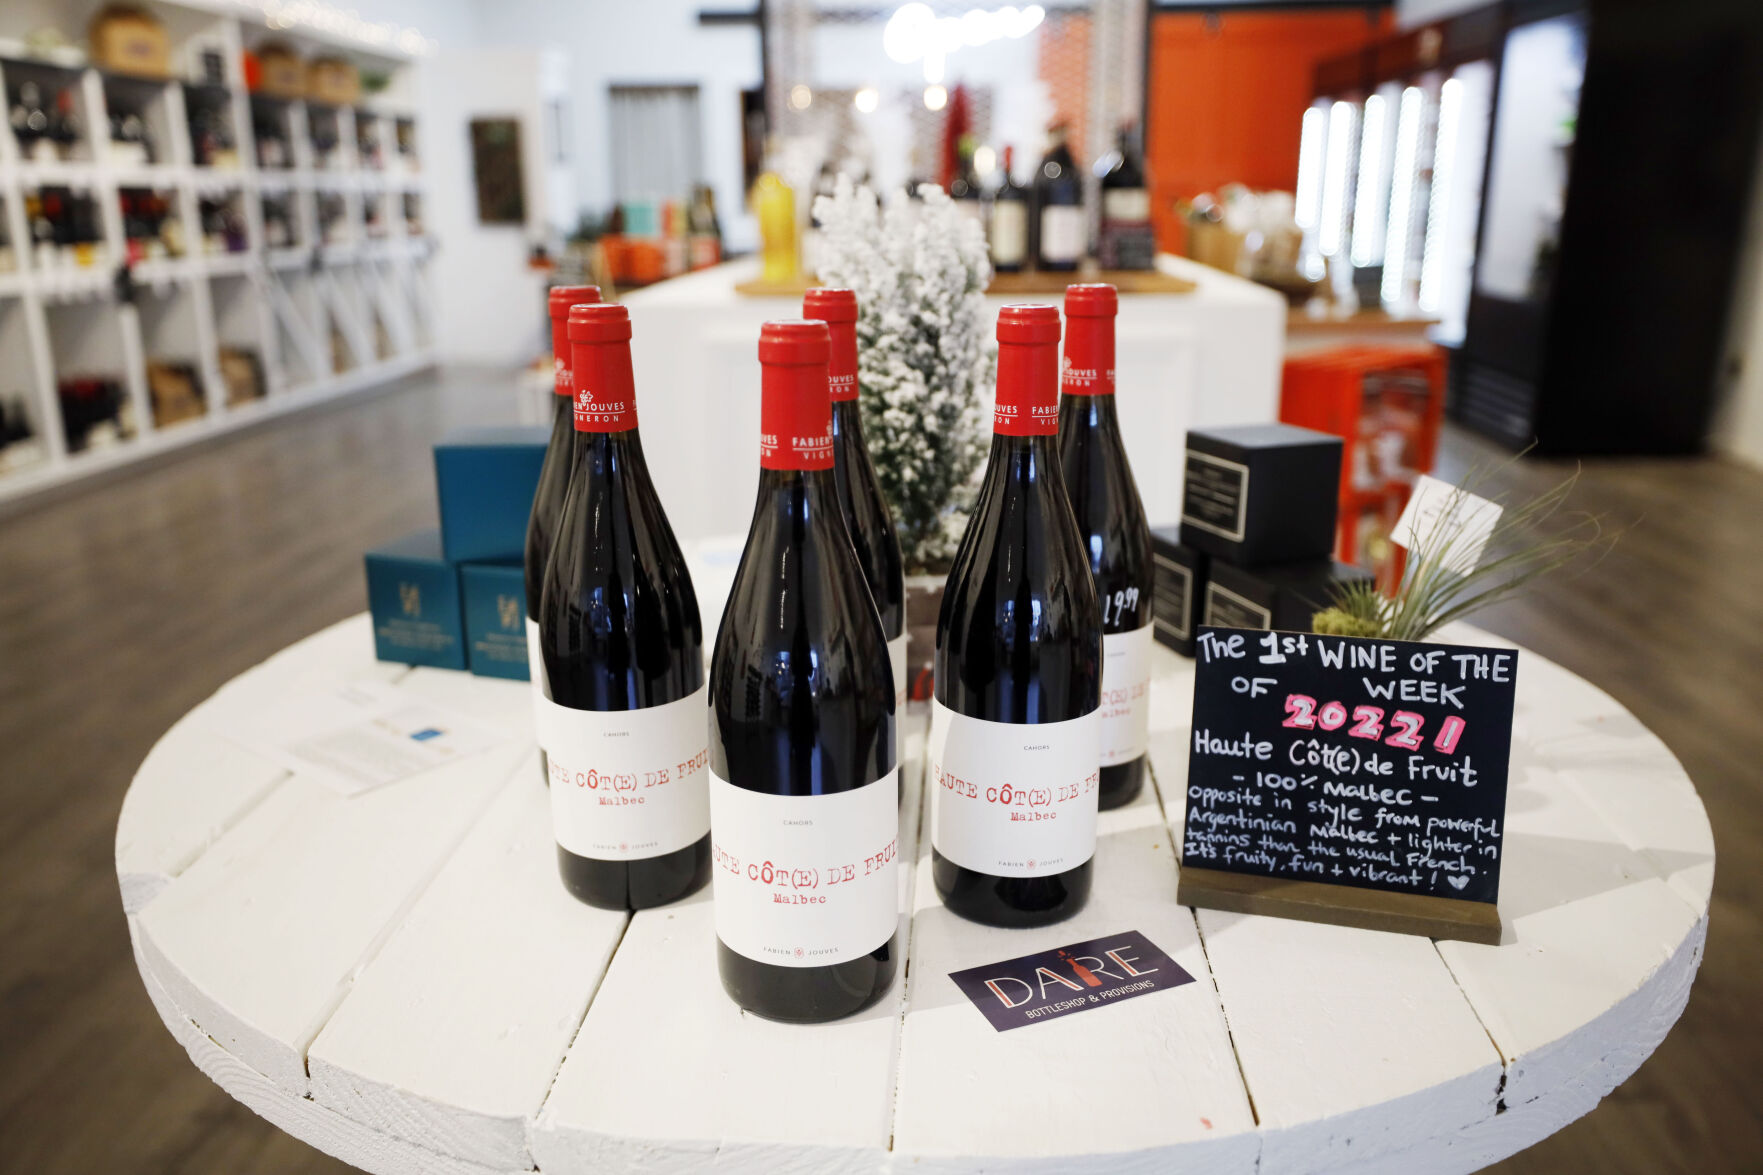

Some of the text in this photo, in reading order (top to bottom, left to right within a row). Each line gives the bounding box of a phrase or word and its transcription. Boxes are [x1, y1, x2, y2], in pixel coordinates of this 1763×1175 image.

[586, 402, 625, 411] JOUVES
[1197, 632, 1511, 682] The 1st WINE OF THE
[1231, 676, 1278, 698] OF
[1363, 677, 1466, 710] WEEK
[575, 768, 638, 793] CÔT(E)
[644, 768, 670, 788] DE
[677, 748, 708, 779] FRUI
[1195, 728, 1273, 760] Haute
[1364, 753, 1394, 775] de
[1408, 755, 1477, 787] Fruit
[986, 783, 1052, 808] CÔT(E)
[1058, 782, 1079, 802] DE
[1257, 771, 1318, 791] 100%
[599, 796, 645, 806] Malbec
[1010, 811, 1057, 822] Malbec
[1273, 791, 1292, 811] in
[1307, 798, 1362, 829] style
[1375, 807, 1421, 829] from
[1426, 817, 1500, 841] powerful
[1186, 826, 1250, 847] tannins
[1257, 834, 1300, 853] than
[1307, 840, 1340, 857] the
[1346, 846, 1400, 867] usual
[1189, 806, 1297, 833] Argentinian
[1310, 824, 1379, 845] Malbec
[1408, 833, 1472, 859] lighter
[1478, 839, 1497, 860] in
[712, 839, 897, 890] UTE CÔT(E) DE FRUI
[1288, 854, 1324, 874] fun
[773, 893, 826, 905] Malbec
[763, 946, 839, 956] FABIEN JOUVES
[984, 945, 1159, 1009] DARE
[1025, 980, 1155, 1019] BOTTLESHOP & PROVISIONS
